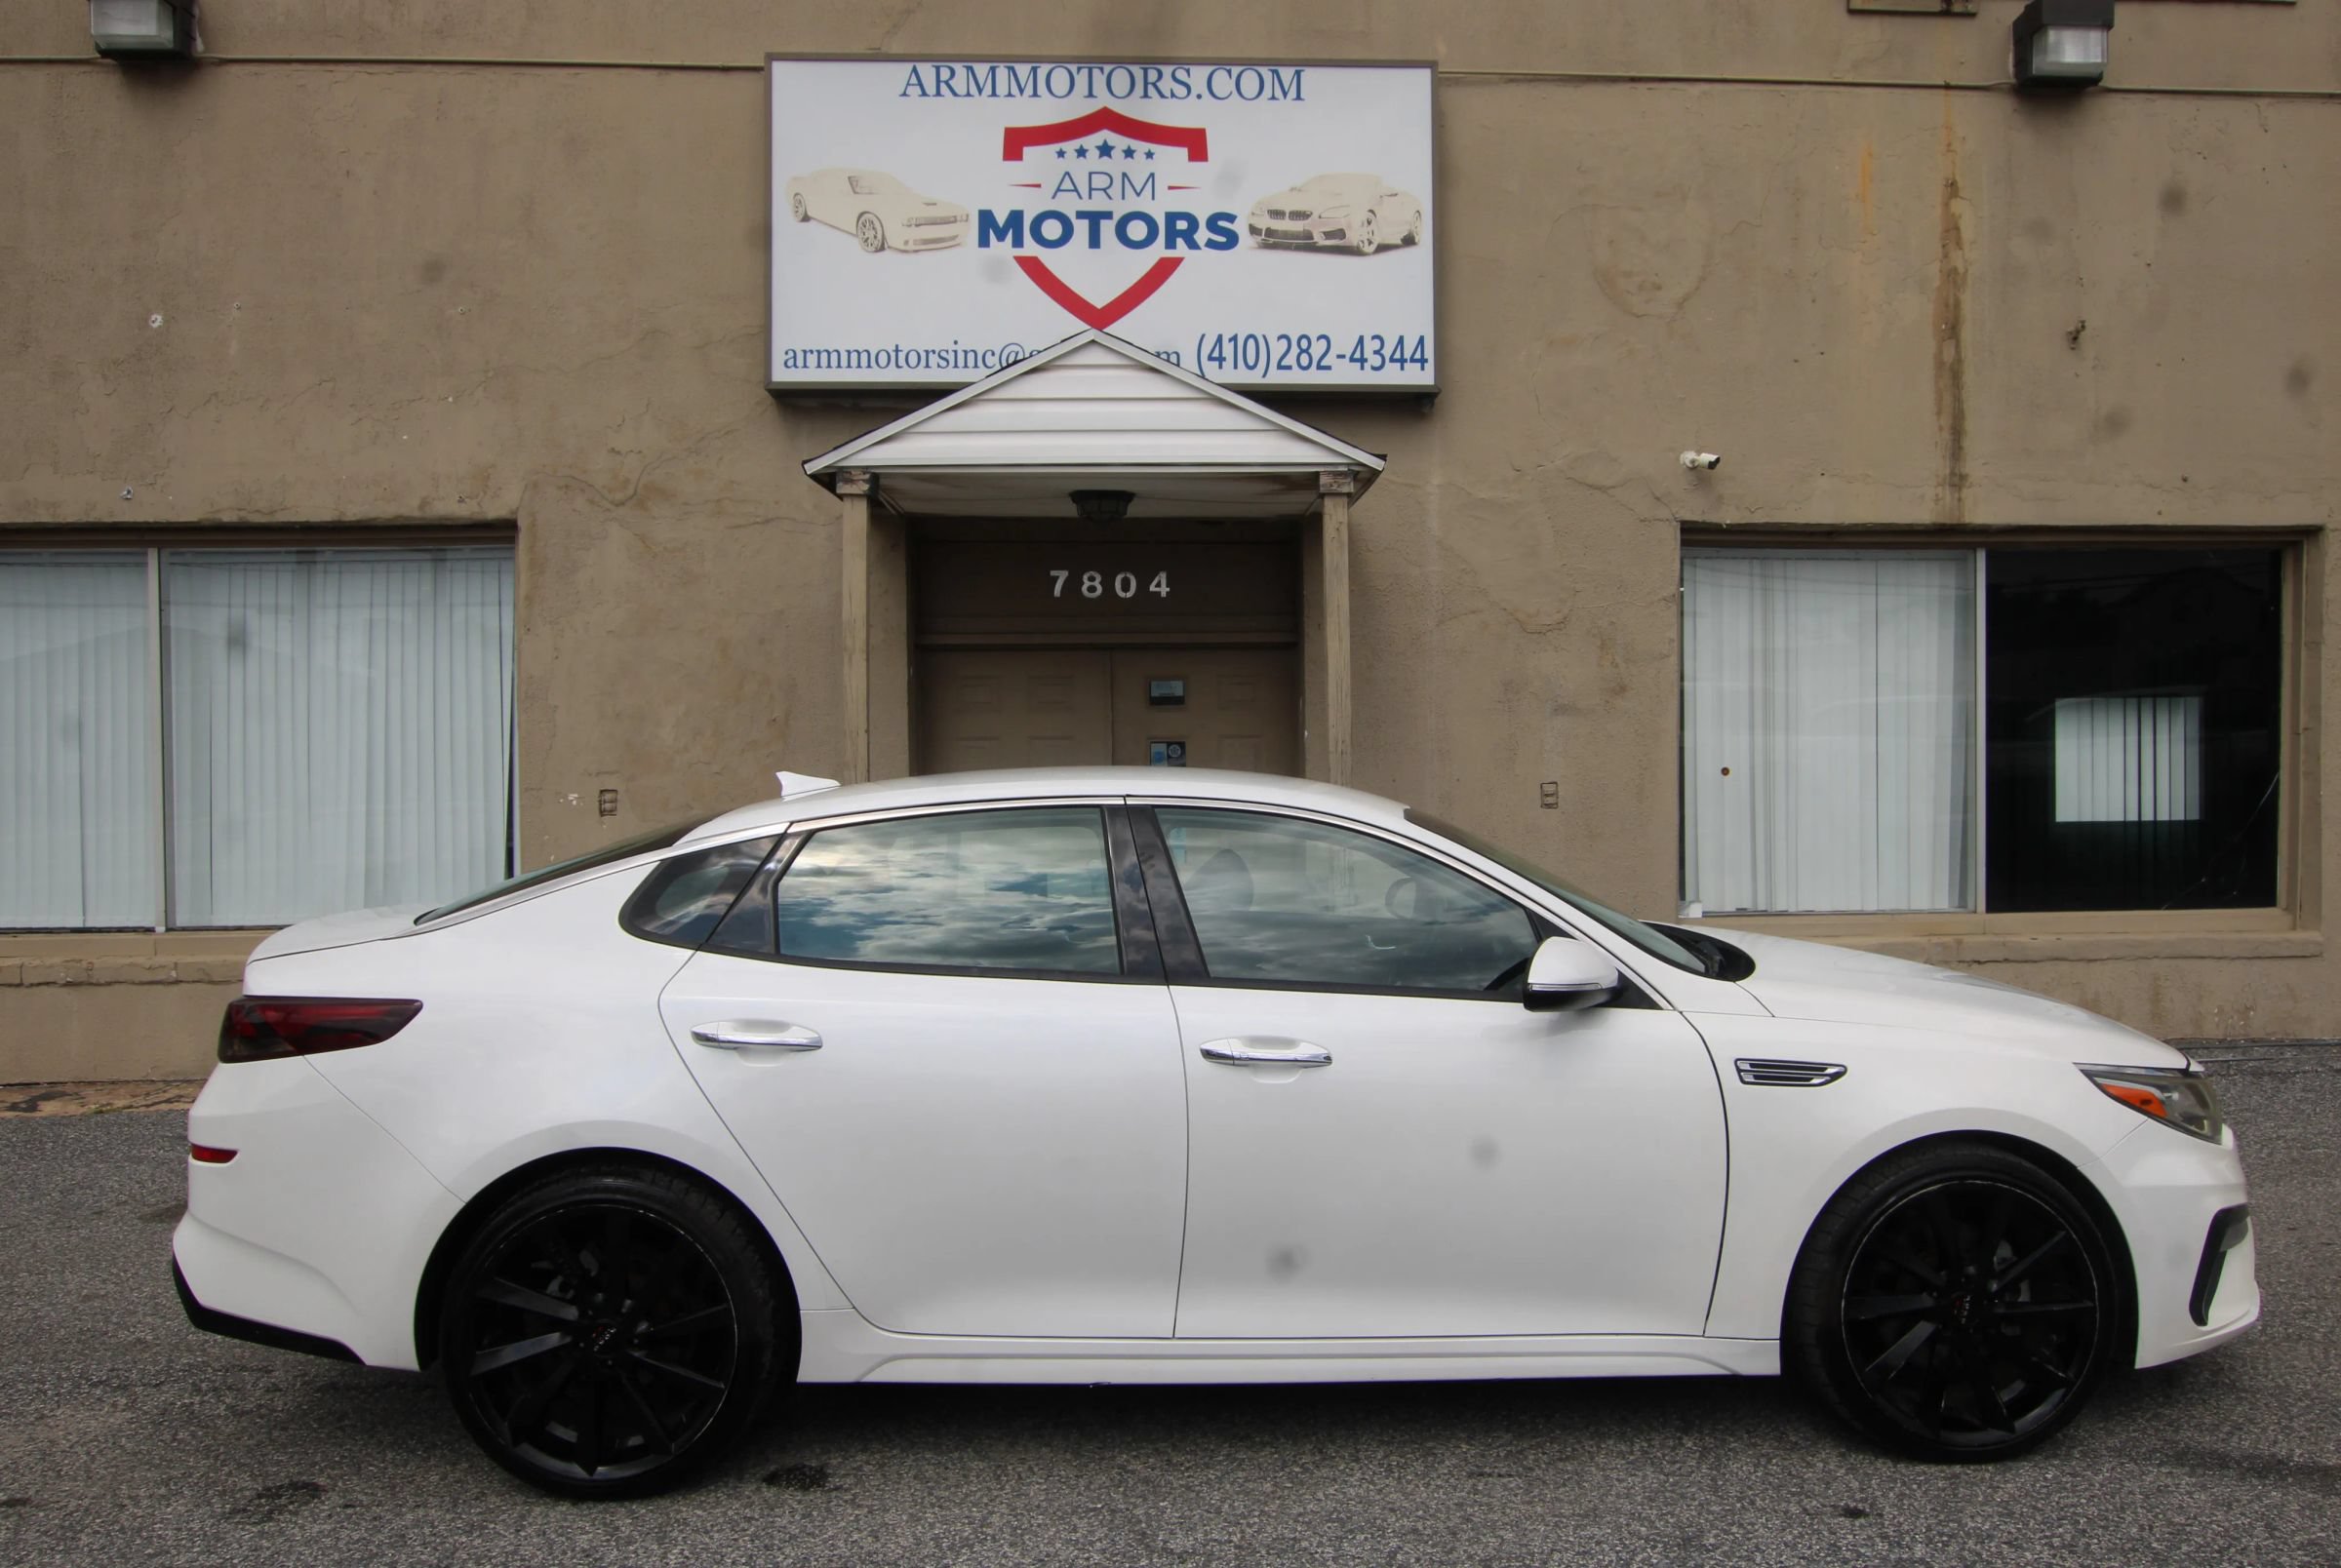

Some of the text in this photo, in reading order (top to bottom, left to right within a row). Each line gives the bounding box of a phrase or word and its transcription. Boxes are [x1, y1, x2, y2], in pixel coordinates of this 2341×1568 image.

[899, 64, 1305, 101] ARMMOTORS.COM
[1051, 171, 1156, 201] ARM
[977, 209, 1240, 251] MOTORS
[1196, 333, 1429, 376] (410)282-4344
[1050, 569, 1170, 599] 7804
